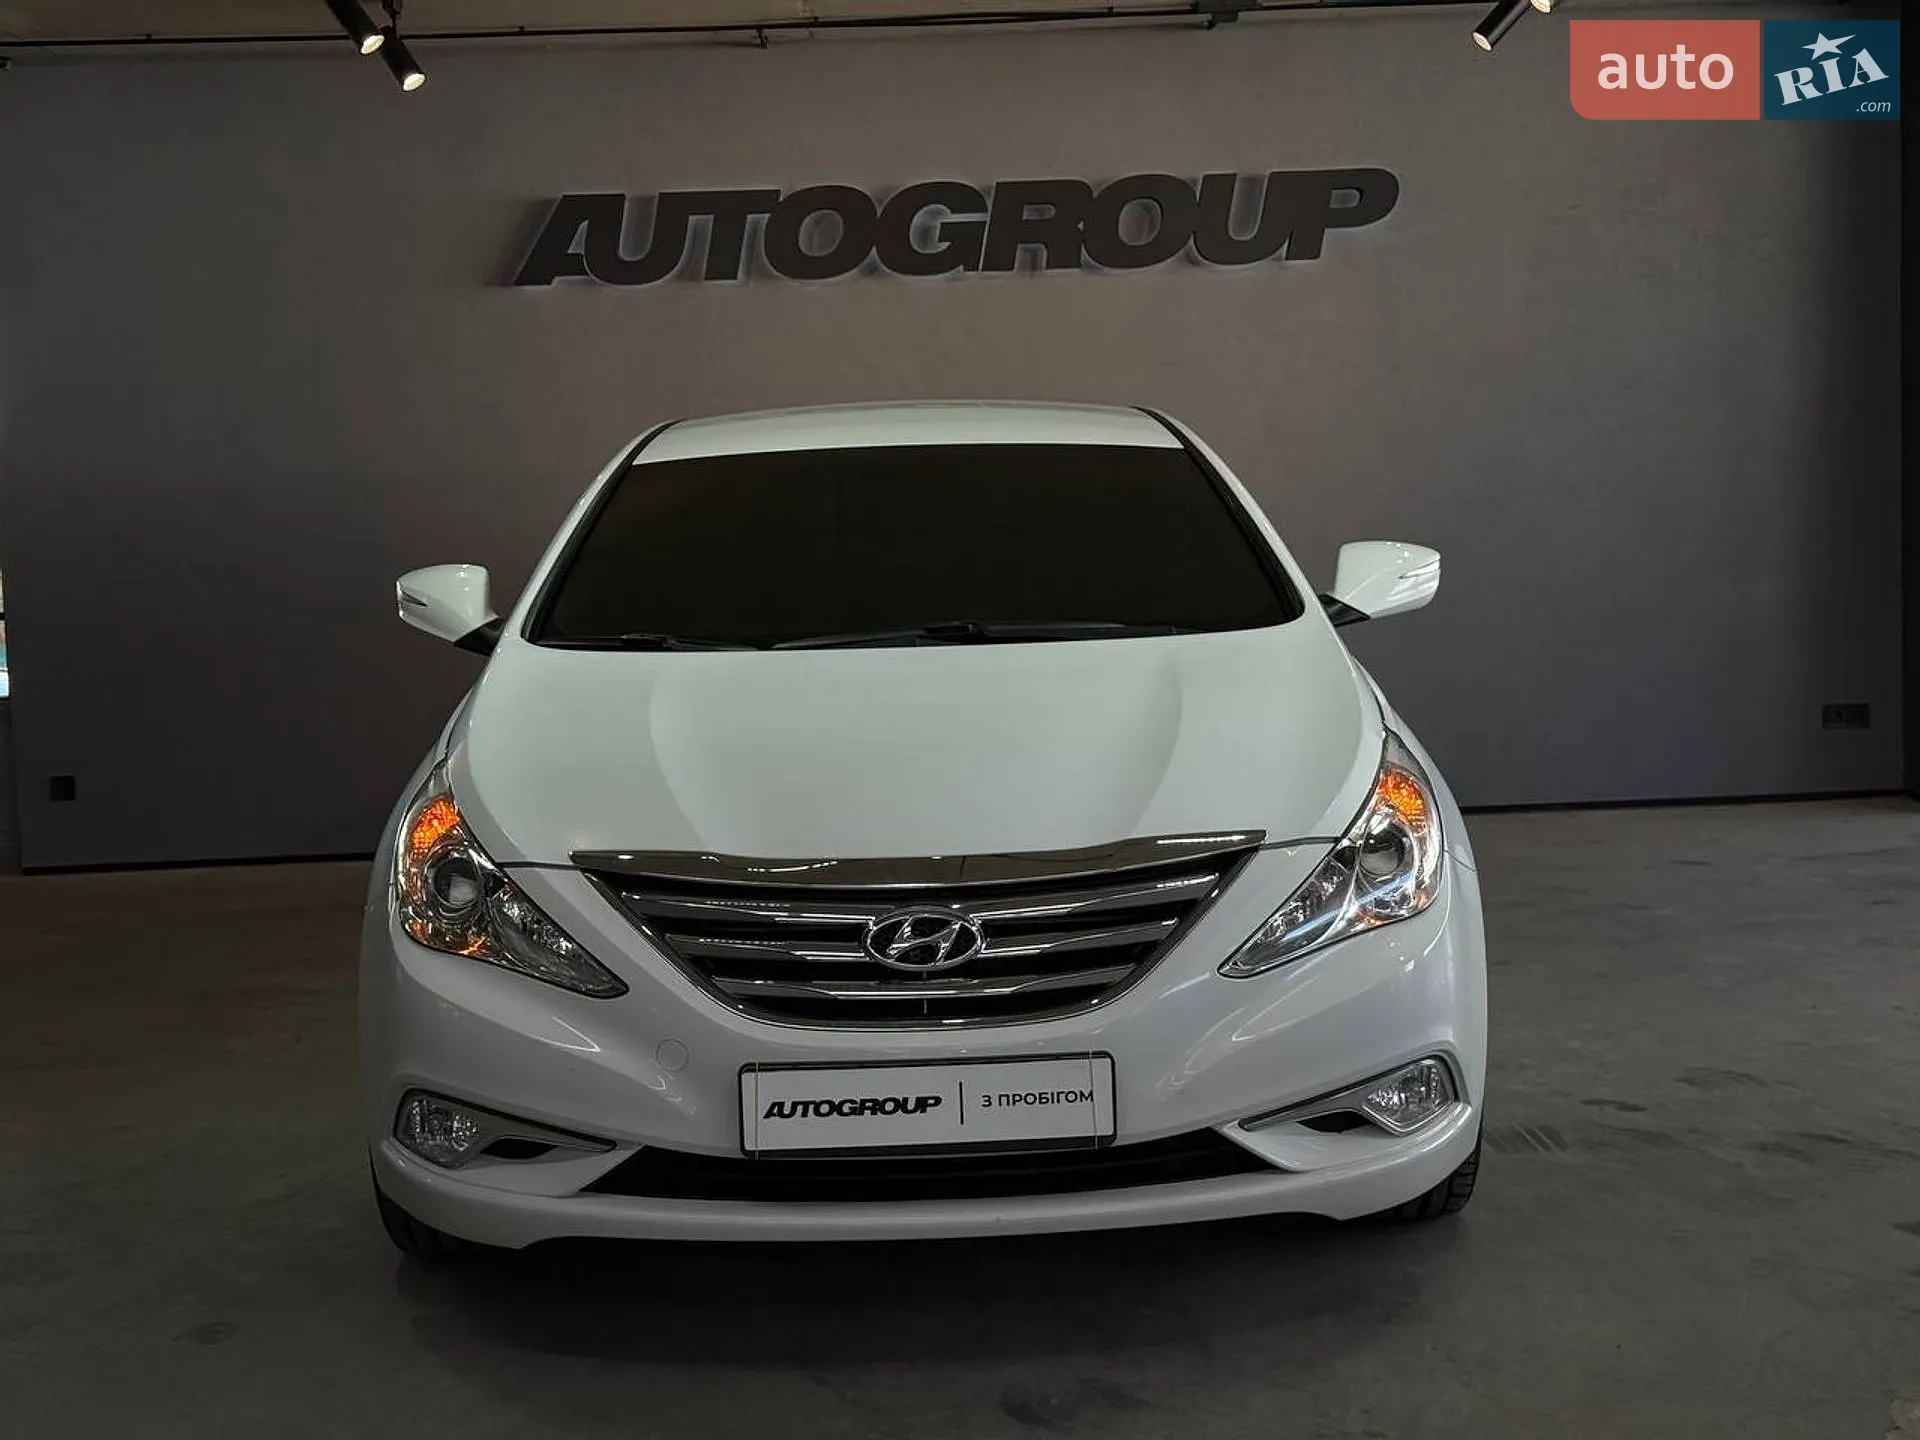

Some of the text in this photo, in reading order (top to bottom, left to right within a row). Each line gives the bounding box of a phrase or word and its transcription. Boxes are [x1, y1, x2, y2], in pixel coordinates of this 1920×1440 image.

[514, 168, 1400, 287] AUTOGROUP
[763, 1095, 943, 1119] AUTOGROUP
[998, 1088, 1095, 1107] ПРОБІГОМ
